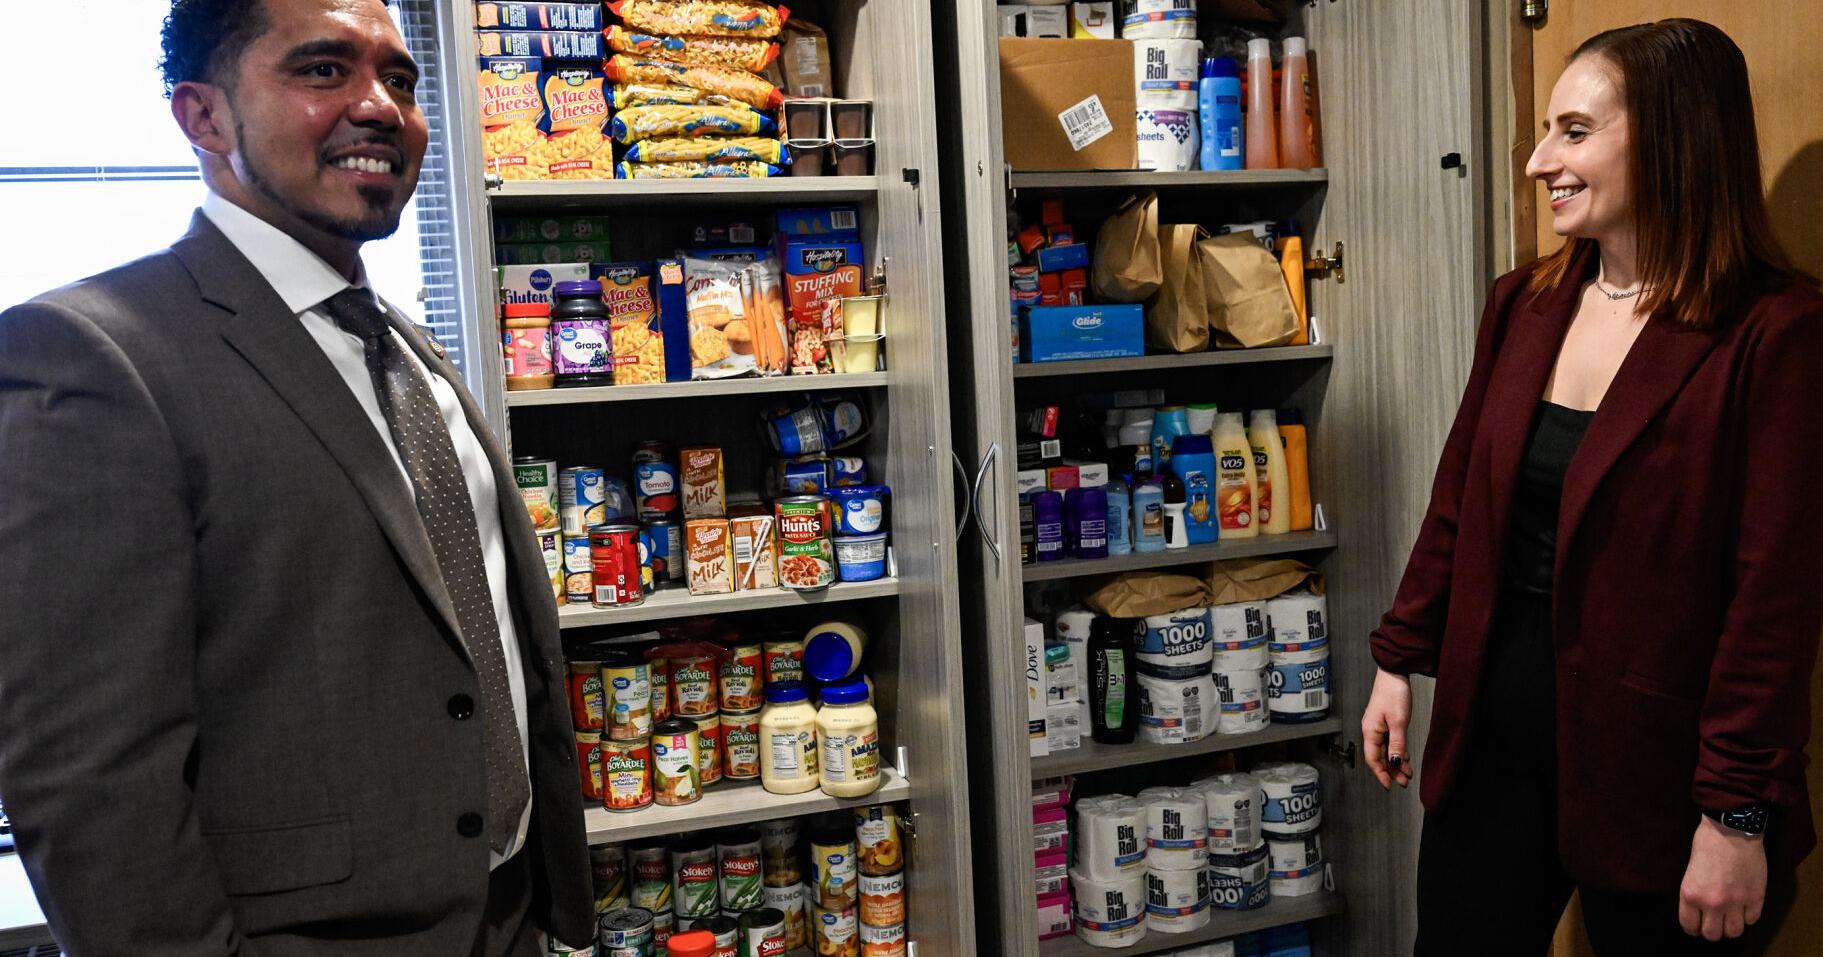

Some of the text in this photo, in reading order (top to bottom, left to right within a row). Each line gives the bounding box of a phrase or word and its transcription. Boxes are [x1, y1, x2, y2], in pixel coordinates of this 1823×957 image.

[1147, 47, 1165, 65] Big
[1146, 64, 1168, 79] Roll
[484, 80, 536, 101] Mac &
[551, 88, 601, 107] Mac &
[483, 96, 539, 118] Cheese
[551, 101, 605, 122] Cheese
[700, 111, 729, 126] Allegra
[1136, 131, 1164, 141] sheets
[723, 144, 750, 157] Allegra
[806, 249, 843, 262] Hospitality
[795, 271, 854, 293] STUFFING
[602, 286, 649, 303] Mac &
[816, 286, 834, 299] MIX
[610, 300, 651, 317] heese
[1076, 315, 1102, 326] Glide
[575, 341, 602, 351] Grape
[1222, 458, 1244, 469] VO5
[517, 475, 544, 485] Choice
[519, 470, 543, 479] Healthy
[781, 518, 821, 533] Hunt's
[693, 560, 725, 582] MiLK
[1245, 607, 1261, 623] Big
[1307, 609, 1322, 625] Big
[1158, 622, 1206, 646] 1000
[1246, 621, 1264, 639] Roll
[1308, 622, 1325, 640] Roll
[1165, 640, 1205, 656] SHEETS
[1026, 644, 1039, 682] Dove
[675, 669, 711, 681] BOYARDEE
[1299, 665, 1326, 682] 1000
[1219, 688, 1234, 703] oll
[607, 758, 646, 771] BOYARDEE
[1163, 809, 1181, 828] Big
[1117, 825, 1134, 842] Big
[1163, 824, 1184, 840] Roll
[1119, 838, 1137, 856] Roll
[1148, 874, 1164, 895] Big
[1105, 890, 1123, 908] Big
[1149, 889, 1168, 907] Roll
[1107, 903, 1127, 922] Roll
